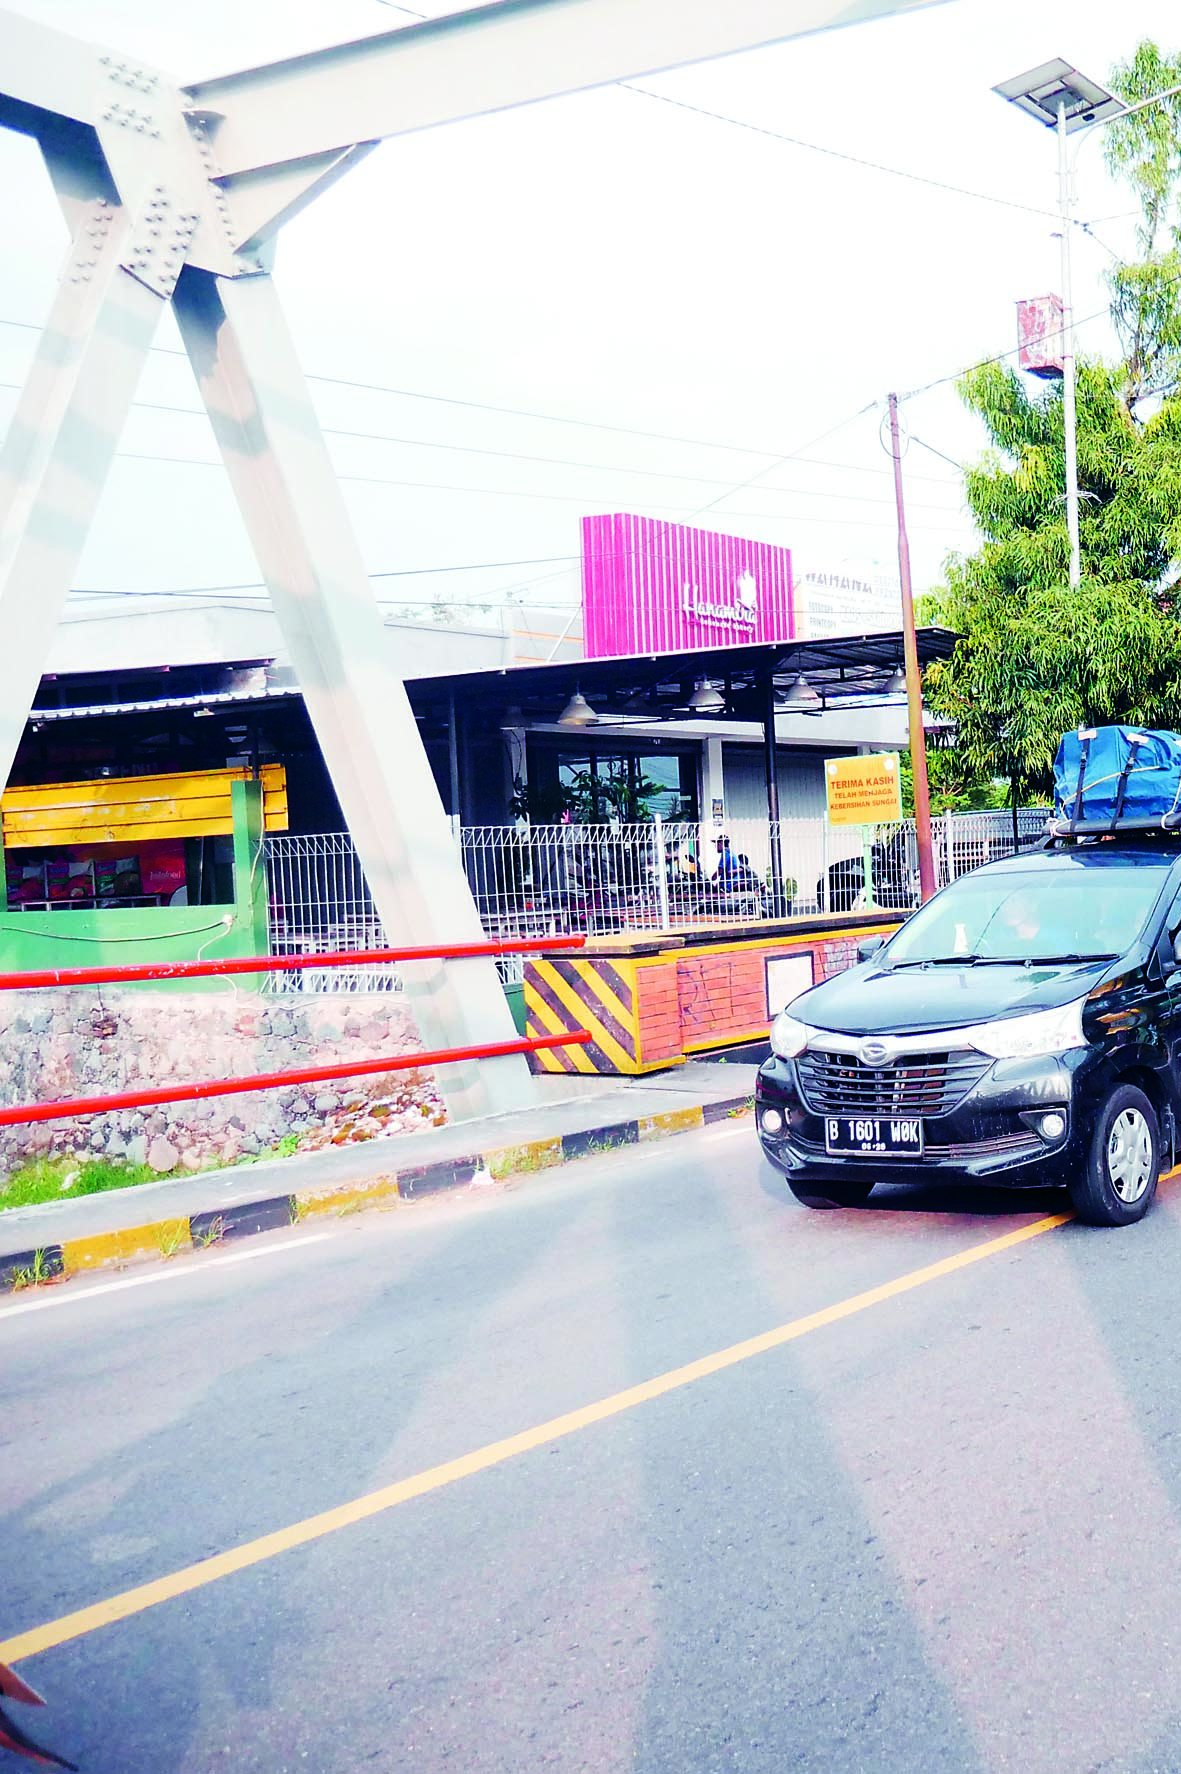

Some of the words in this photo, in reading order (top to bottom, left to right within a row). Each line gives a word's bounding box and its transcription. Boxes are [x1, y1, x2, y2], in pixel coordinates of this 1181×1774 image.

[831, 779, 864, 789] TERIMA
[866, 776, 894, 786] KASIH
[835, 791, 857, 799] TELAH
[858, 788, 893, 797] MENJAGA
[830, 801, 871, 810] KEBERSIHAN
[872, 798, 897, 806] SUNGAI
[829, 1120, 839, 1141] B
[848, 1120, 880, 1142] 1601
[890, 1121, 919, 1143] WOK
